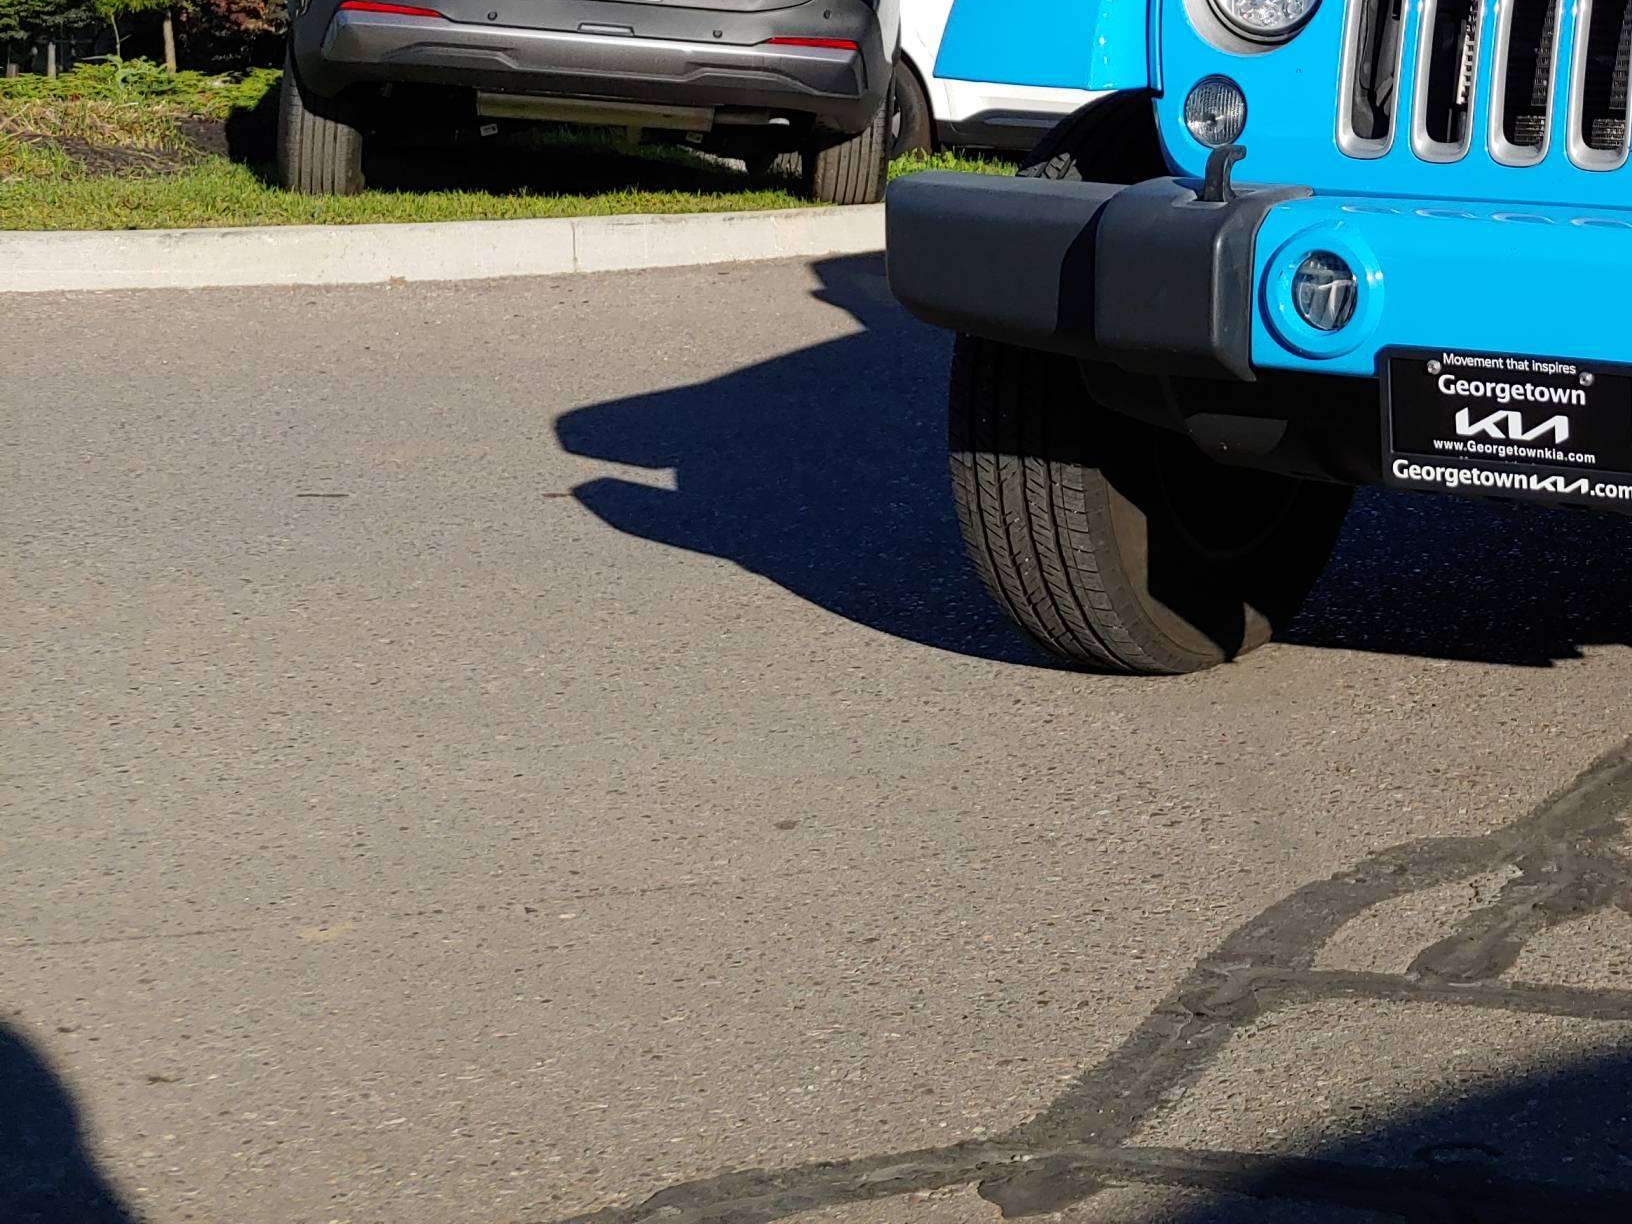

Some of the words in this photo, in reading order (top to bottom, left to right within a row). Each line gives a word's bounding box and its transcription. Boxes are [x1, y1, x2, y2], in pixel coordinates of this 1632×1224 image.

[1443, 353, 1505, 369] Movement
[1506, 358, 1530, 370] that
[1532, 360, 1576, 375] inspires
[1438, 374, 1586, 405] Georgetown
[1455, 406, 1569, 444] KIA
[1433, 439, 1596, 464] www.Georgetownkia.com
